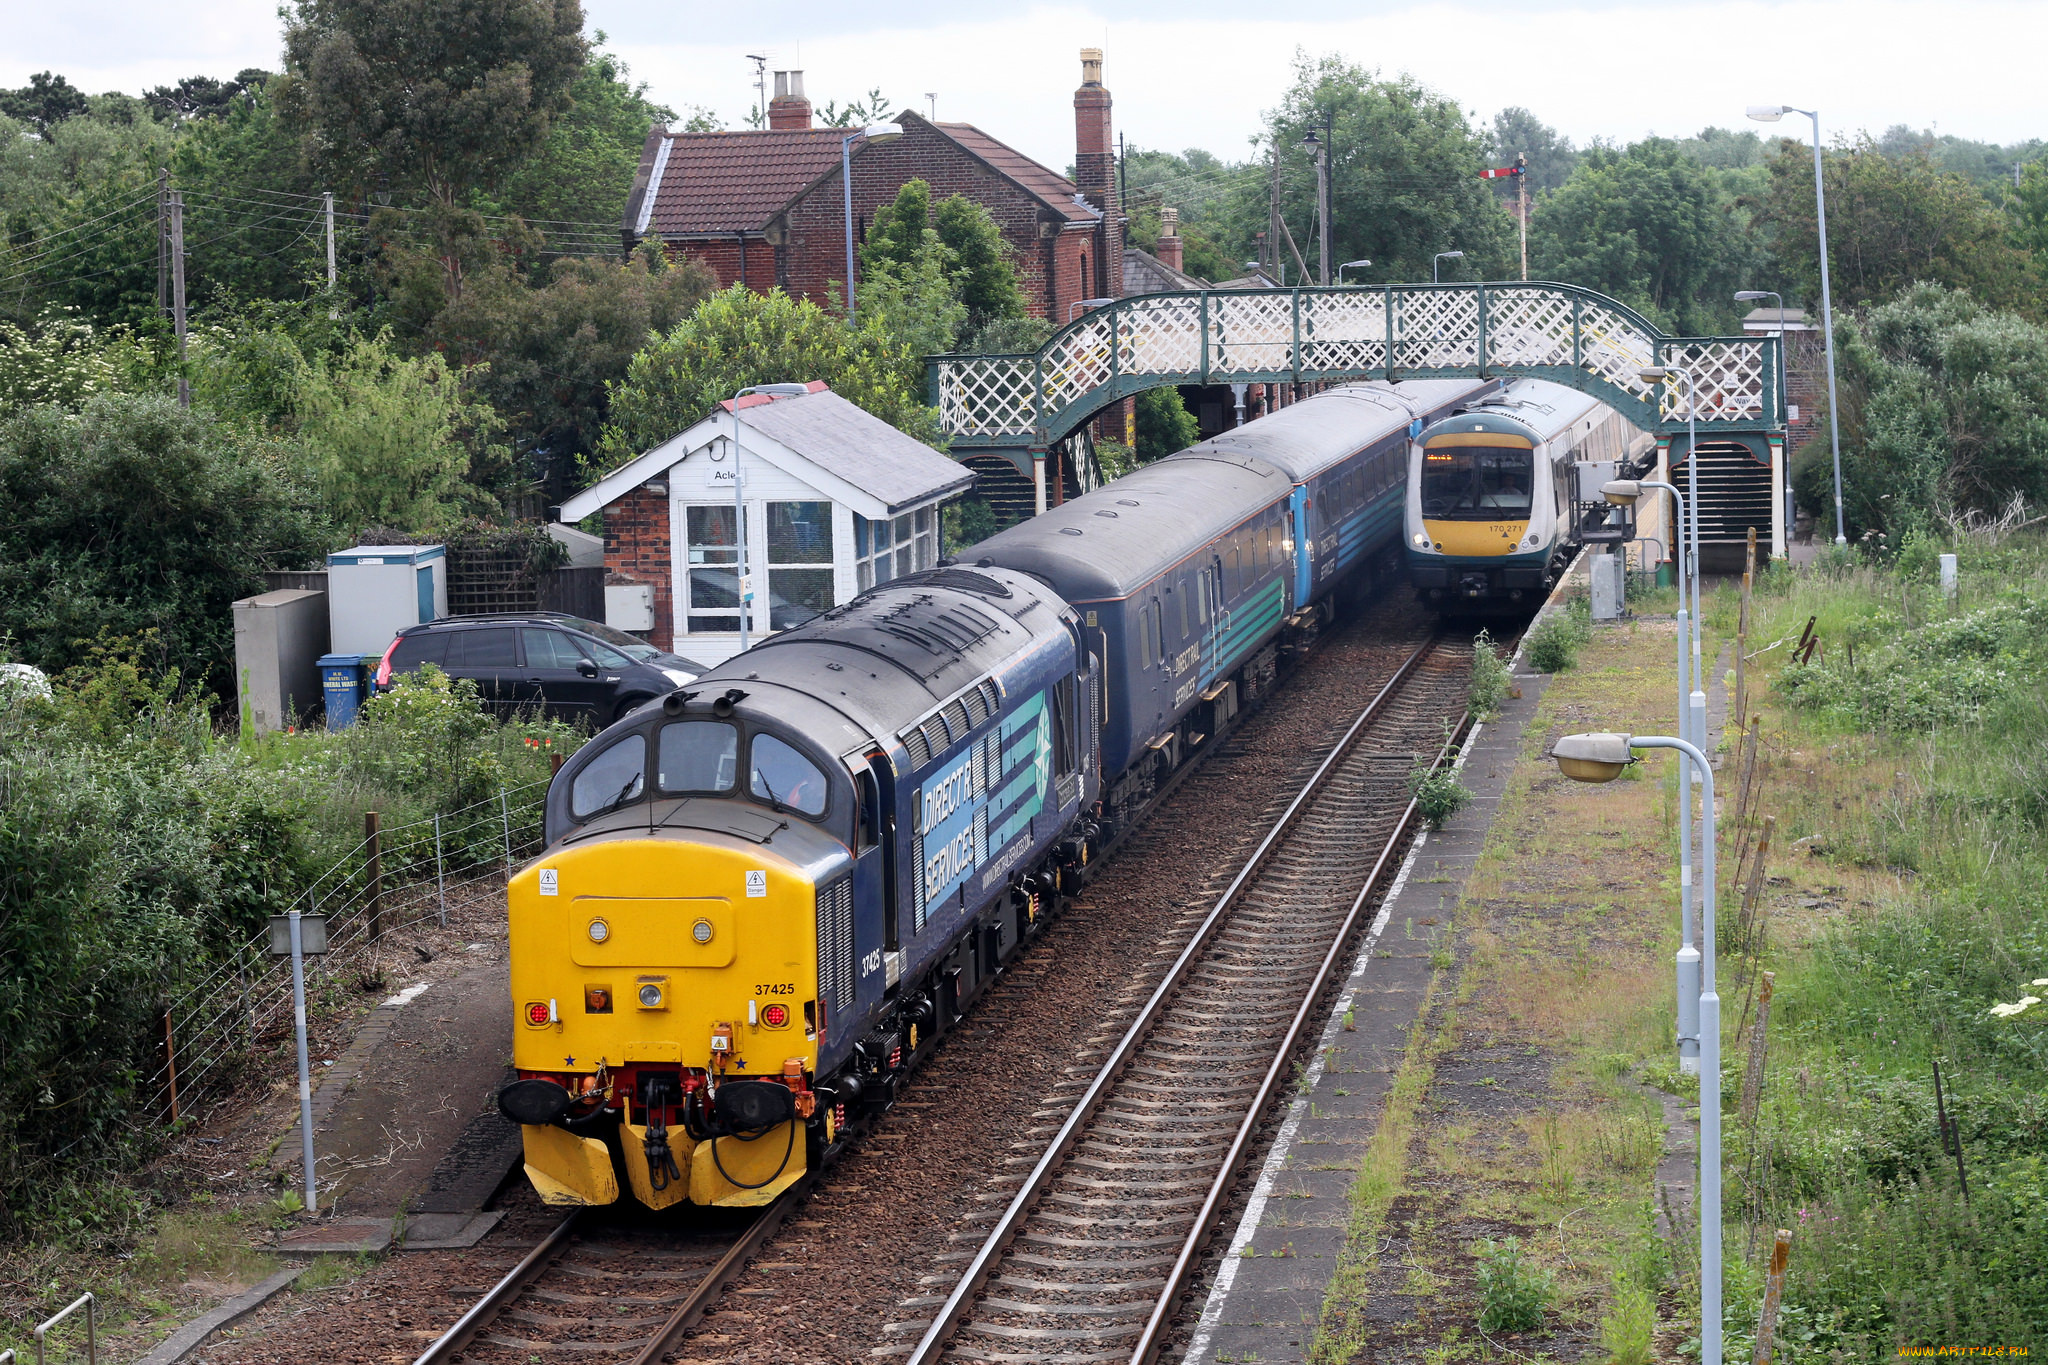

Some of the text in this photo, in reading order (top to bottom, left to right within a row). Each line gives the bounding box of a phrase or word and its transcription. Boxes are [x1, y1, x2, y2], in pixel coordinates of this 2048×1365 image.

[714, 471, 736, 480] Acle
[1176, 647, 1191, 678] DIRECT
[1175, 675, 1196, 710] SERVICES
[924, 767, 964, 838] DIRECT
[925, 822, 975, 905] SERVICES
[862, 947, 880, 978] 37425
[755, 983, 795, 996] 37425
